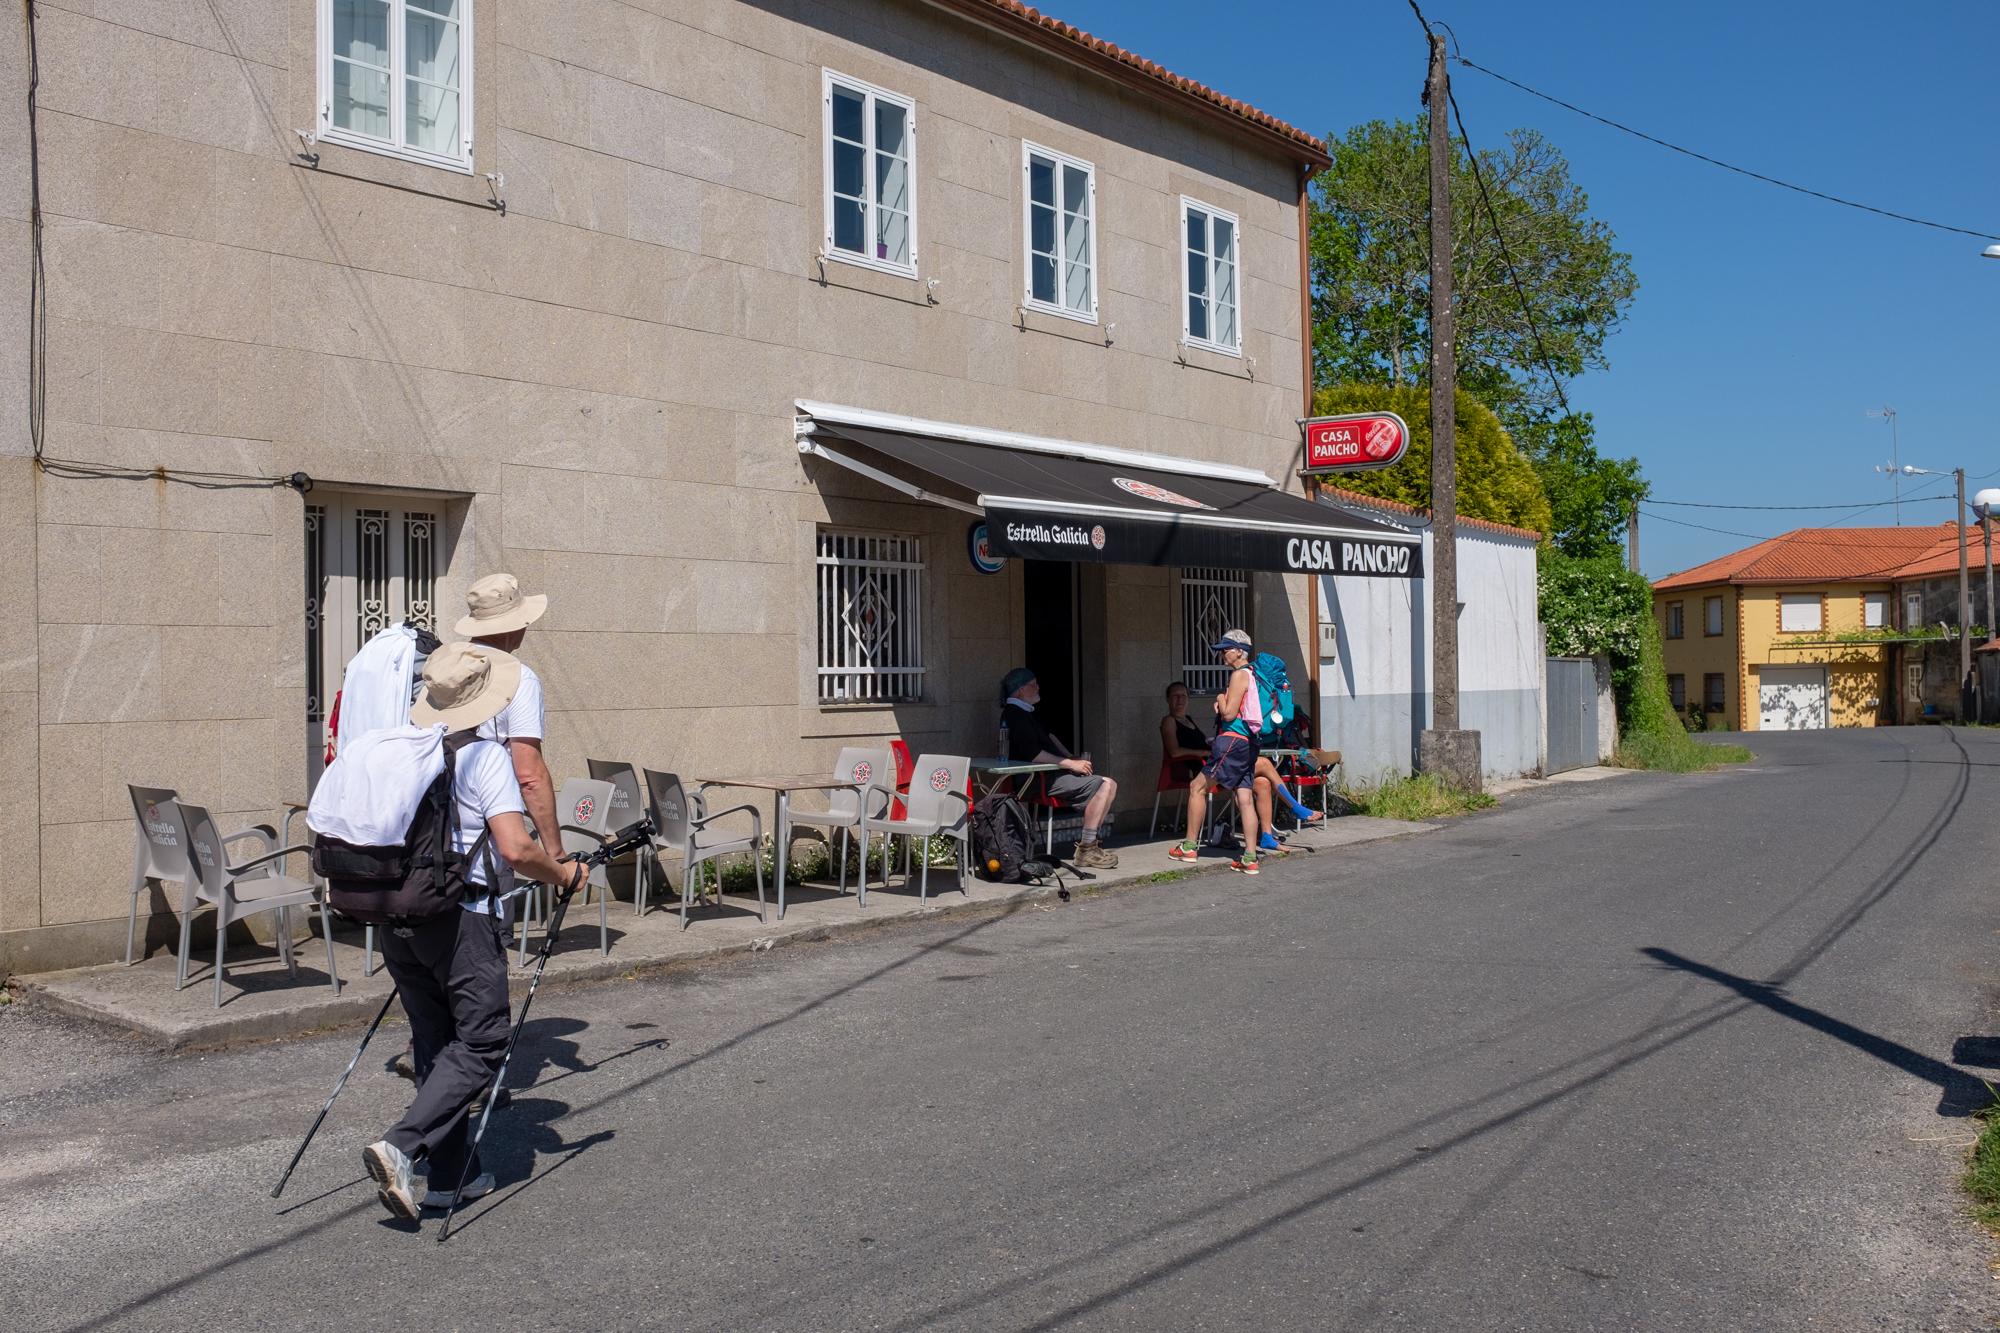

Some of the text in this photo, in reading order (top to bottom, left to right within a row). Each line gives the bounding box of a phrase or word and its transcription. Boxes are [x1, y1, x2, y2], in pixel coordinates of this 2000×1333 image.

[1321, 431, 1351, 443] CASA
[1314, 443, 1358, 457] PANCHO
[1007, 522, 1089, 545] Estrella Galicia
[1287, 538, 1410, 574] CASA PANCHO
